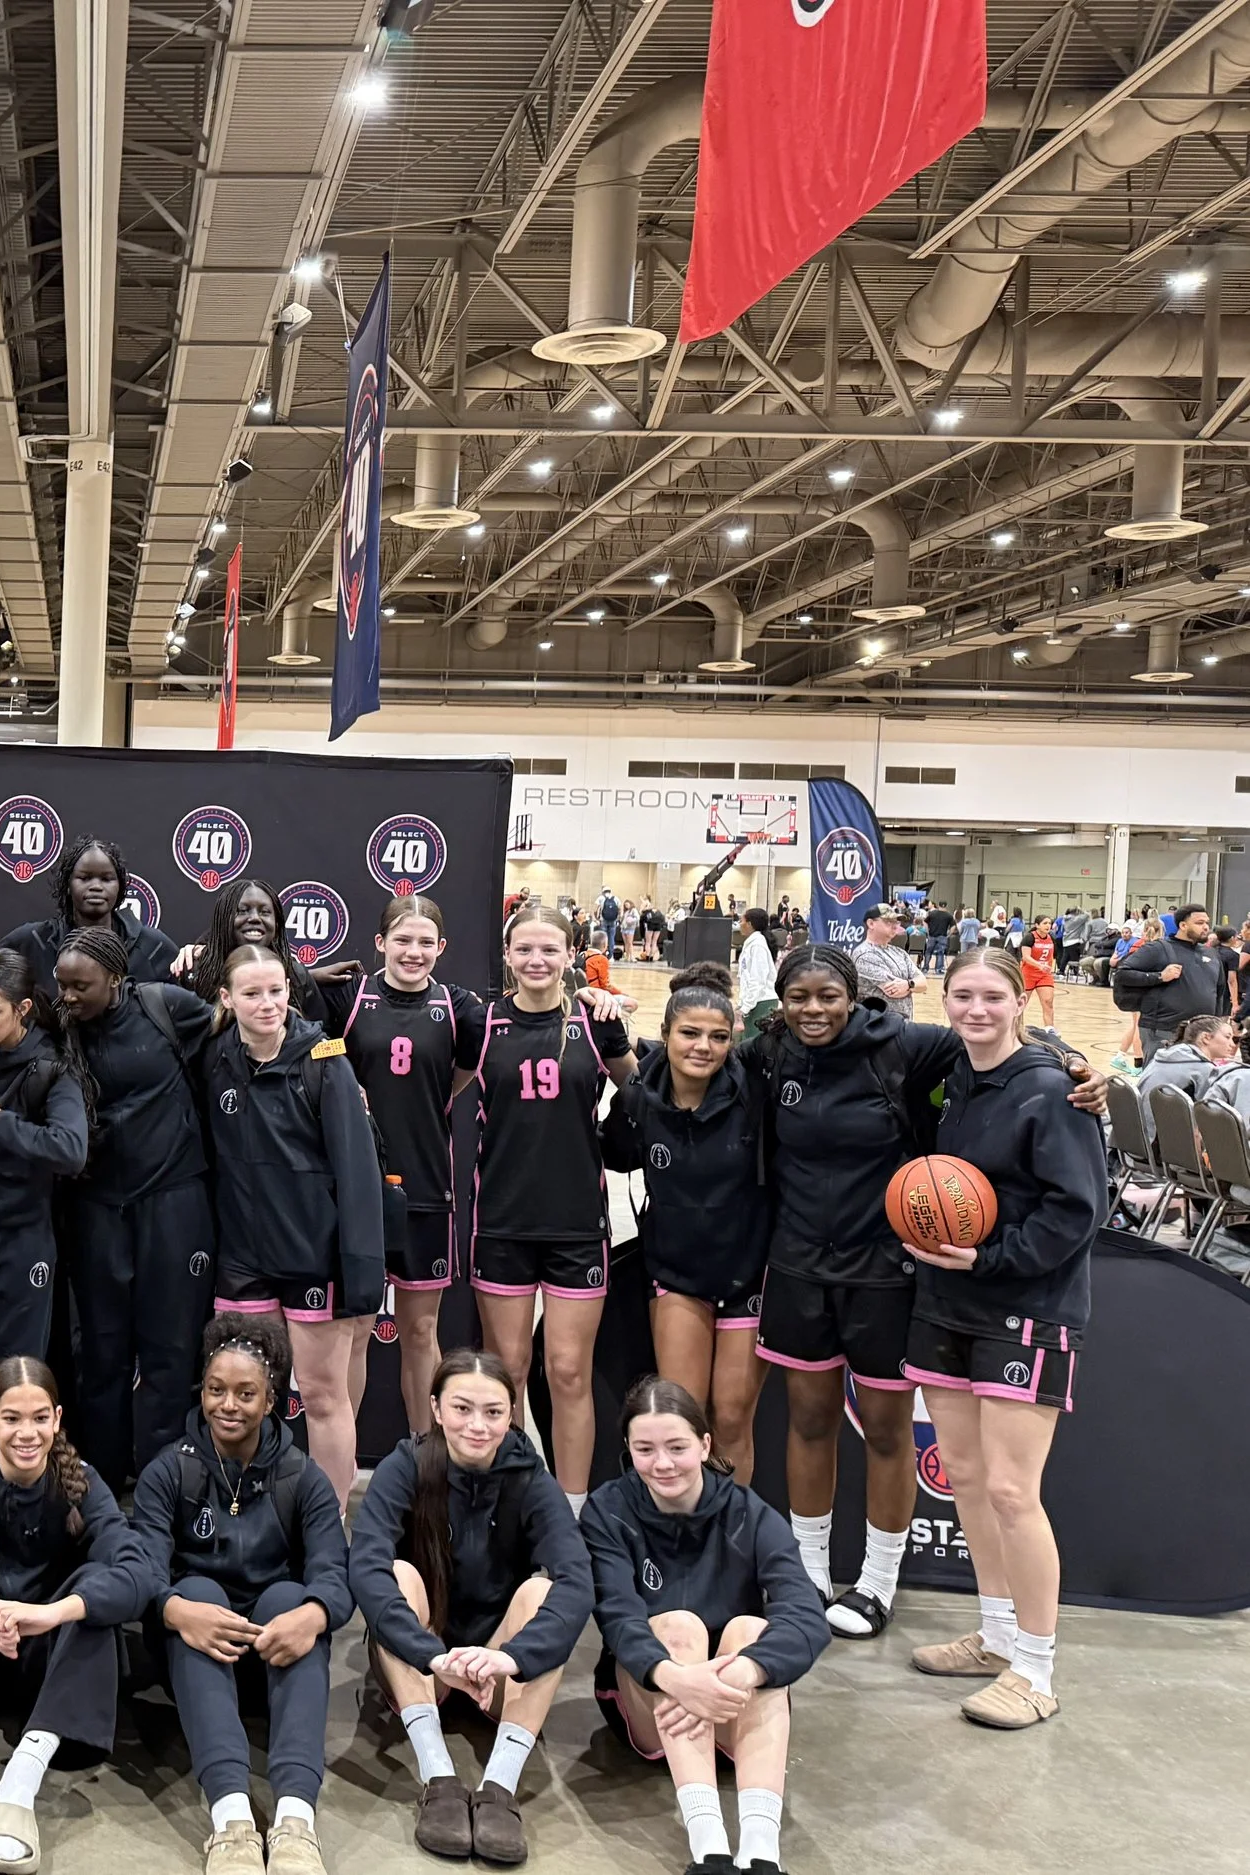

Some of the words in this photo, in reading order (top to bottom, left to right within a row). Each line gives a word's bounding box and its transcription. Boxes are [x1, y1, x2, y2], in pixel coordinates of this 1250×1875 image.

[353, 412, 372, 453] SELECT
[69, 460, 83, 472] E42
[97, 460, 111, 473] E42
[346, 437, 372, 561] 40
[9, 812, 42, 820] SELECT
[524, 787, 738, 810] RESTROOM
[0, 821, 45, 856] 40
[196, 822, 230, 830] SELECT
[187, 830, 233, 865] 40
[380, 839, 428, 874] 40
[825, 849, 862, 880] 40
[285, 906, 330, 940] 40
[827, 919, 865, 942] Take
[390, 1036, 413, 1076] 8
[519, 1058, 560, 1100] 19
[915, 1183, 943, 1242] LEGACY
[941, 1174, 974, 1241] SPALDING
